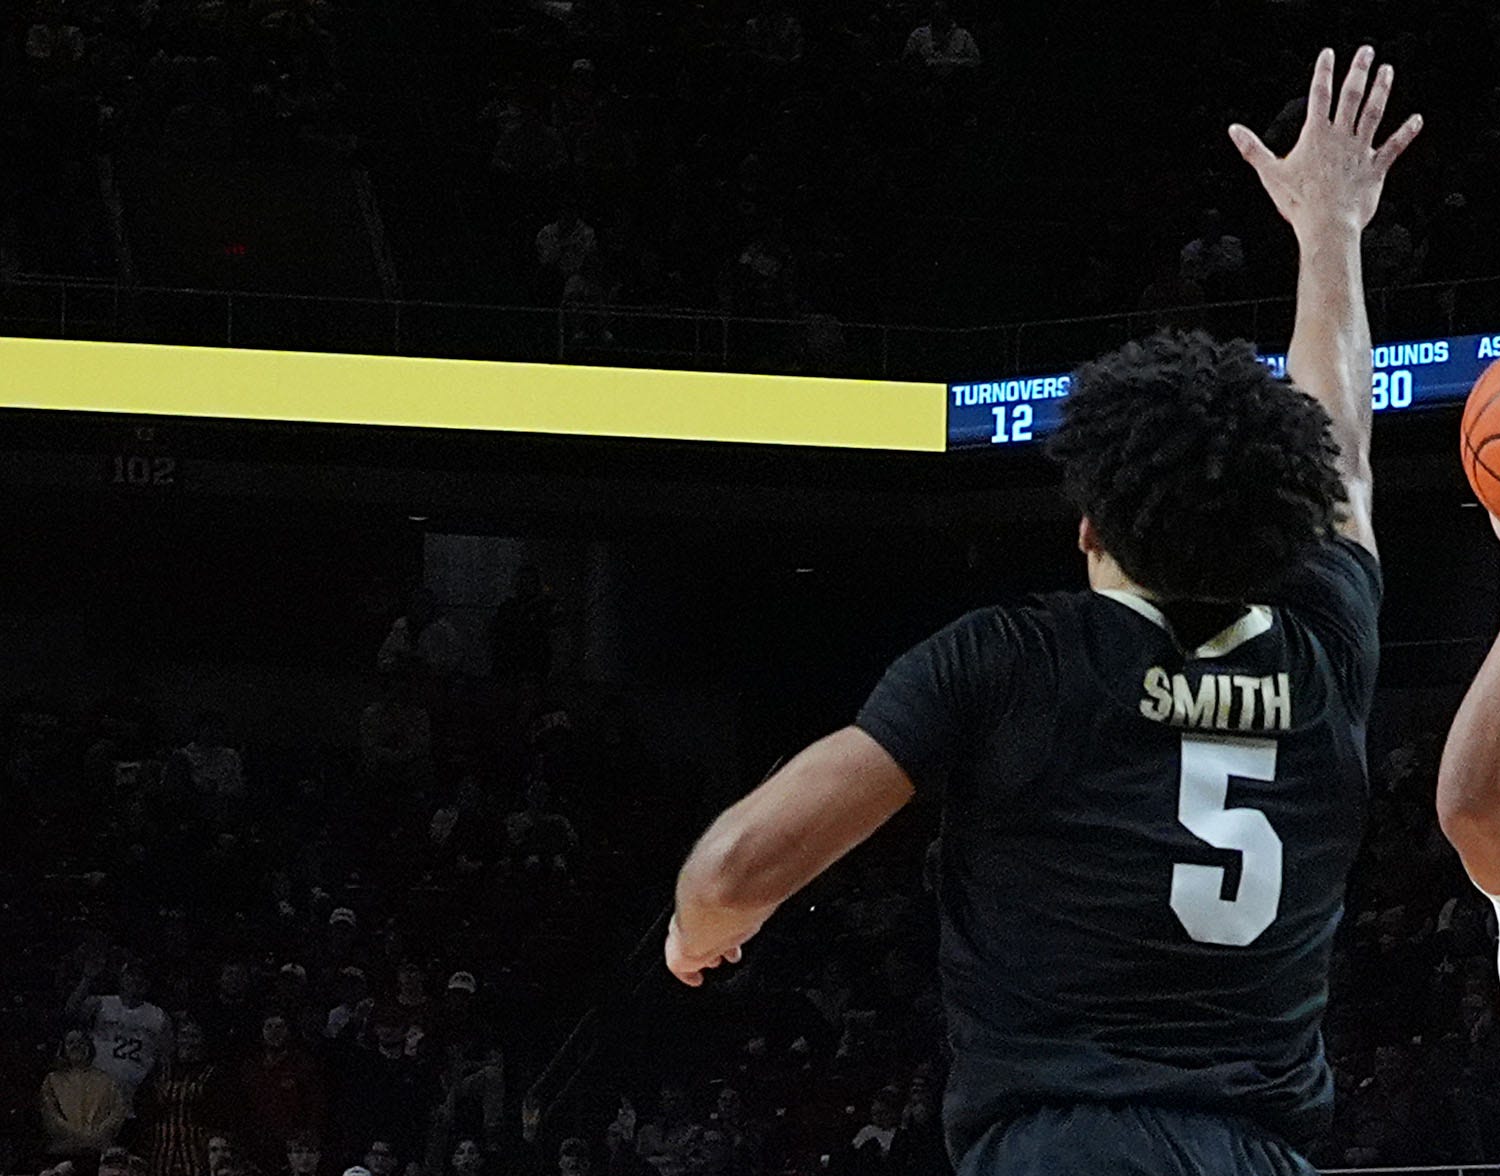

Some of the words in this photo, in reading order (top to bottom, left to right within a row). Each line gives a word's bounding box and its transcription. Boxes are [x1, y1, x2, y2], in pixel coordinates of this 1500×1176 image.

[951, 376, 1071, 407] TURNOVERS
[1370, 369, 1413, 410] 30
[991, 403, 1033, 443] 12
[1139, 666, 1292, 731] SMITH
[1169, 732, 1284, 947] 5
[113, 1036, 142, 1061] 22
